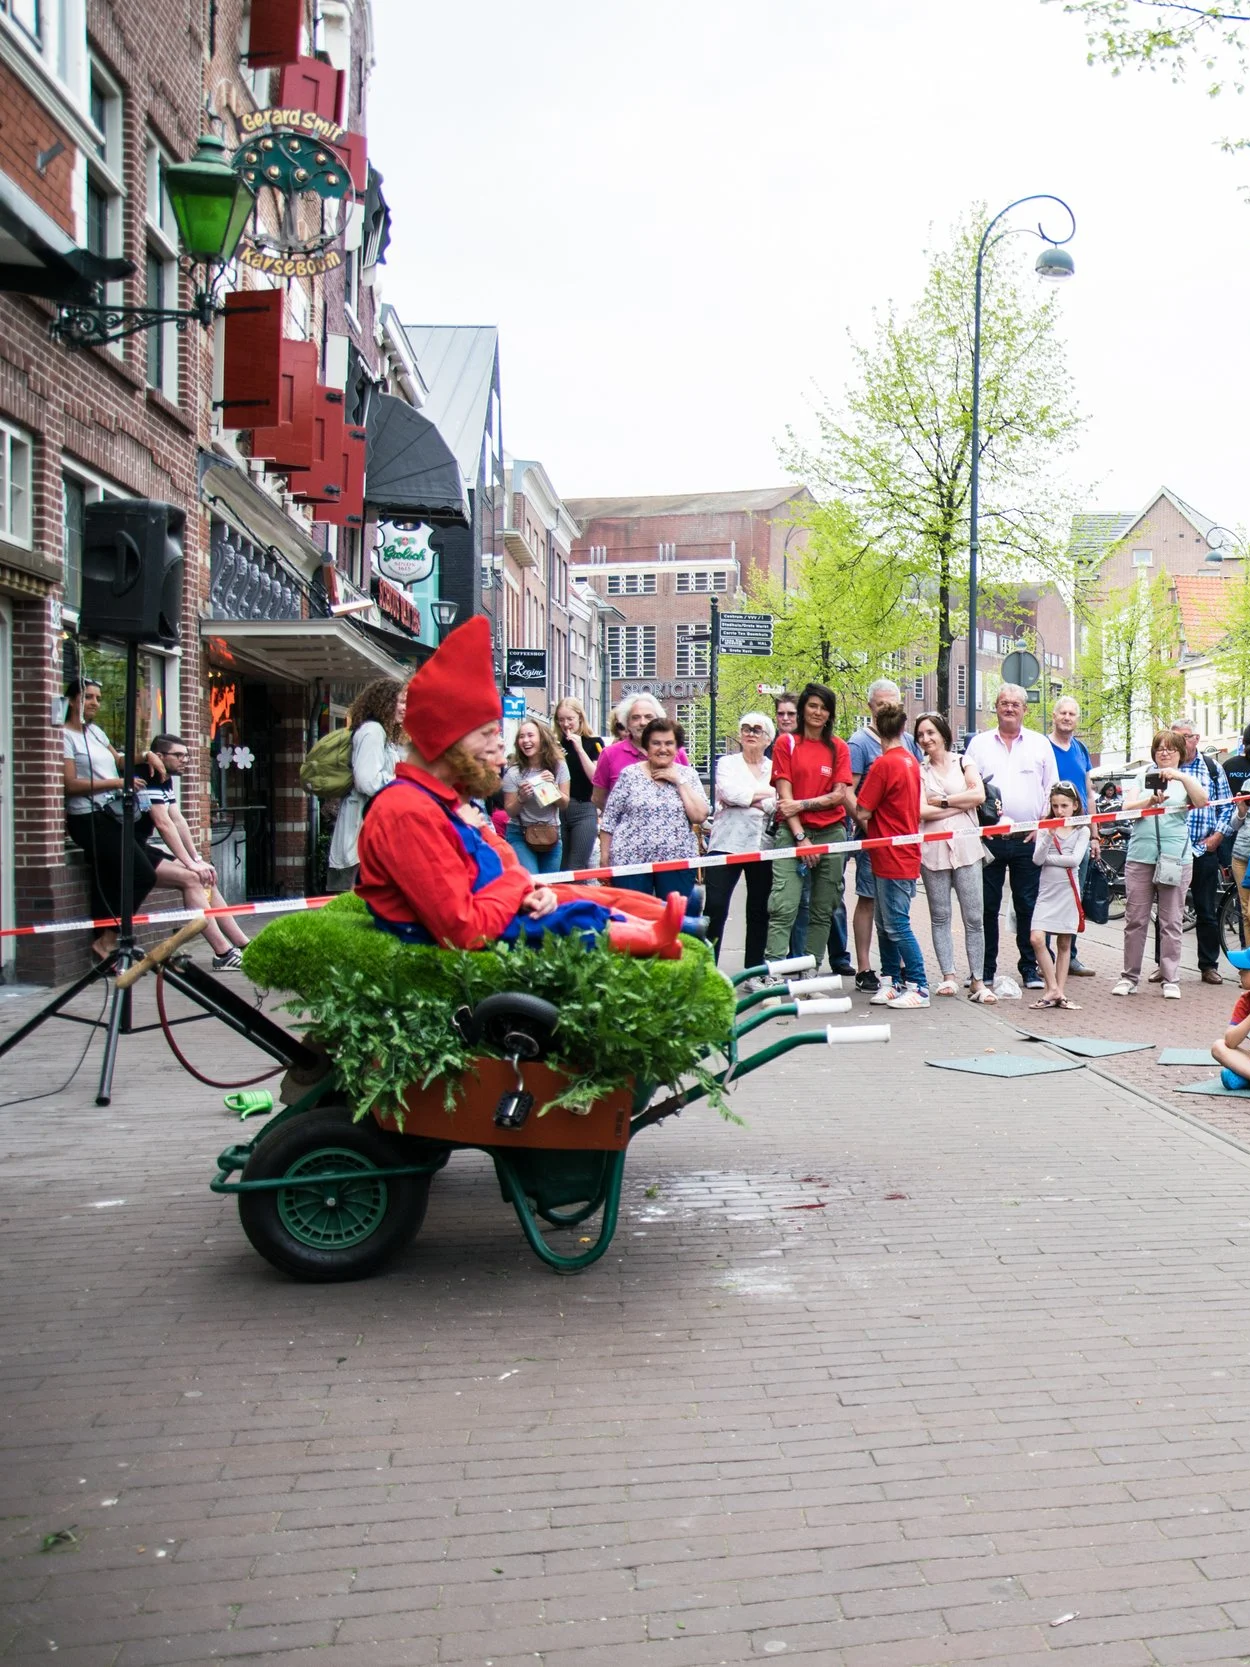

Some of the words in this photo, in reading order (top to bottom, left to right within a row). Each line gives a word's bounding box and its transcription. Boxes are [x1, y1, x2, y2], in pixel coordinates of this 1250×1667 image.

[242, 109, 300, 131] Gerard
[301, 112, 344, 142] Smit
[383, 545, 426, 561] Grolsch
[509, 663, 544, 680] Regine
